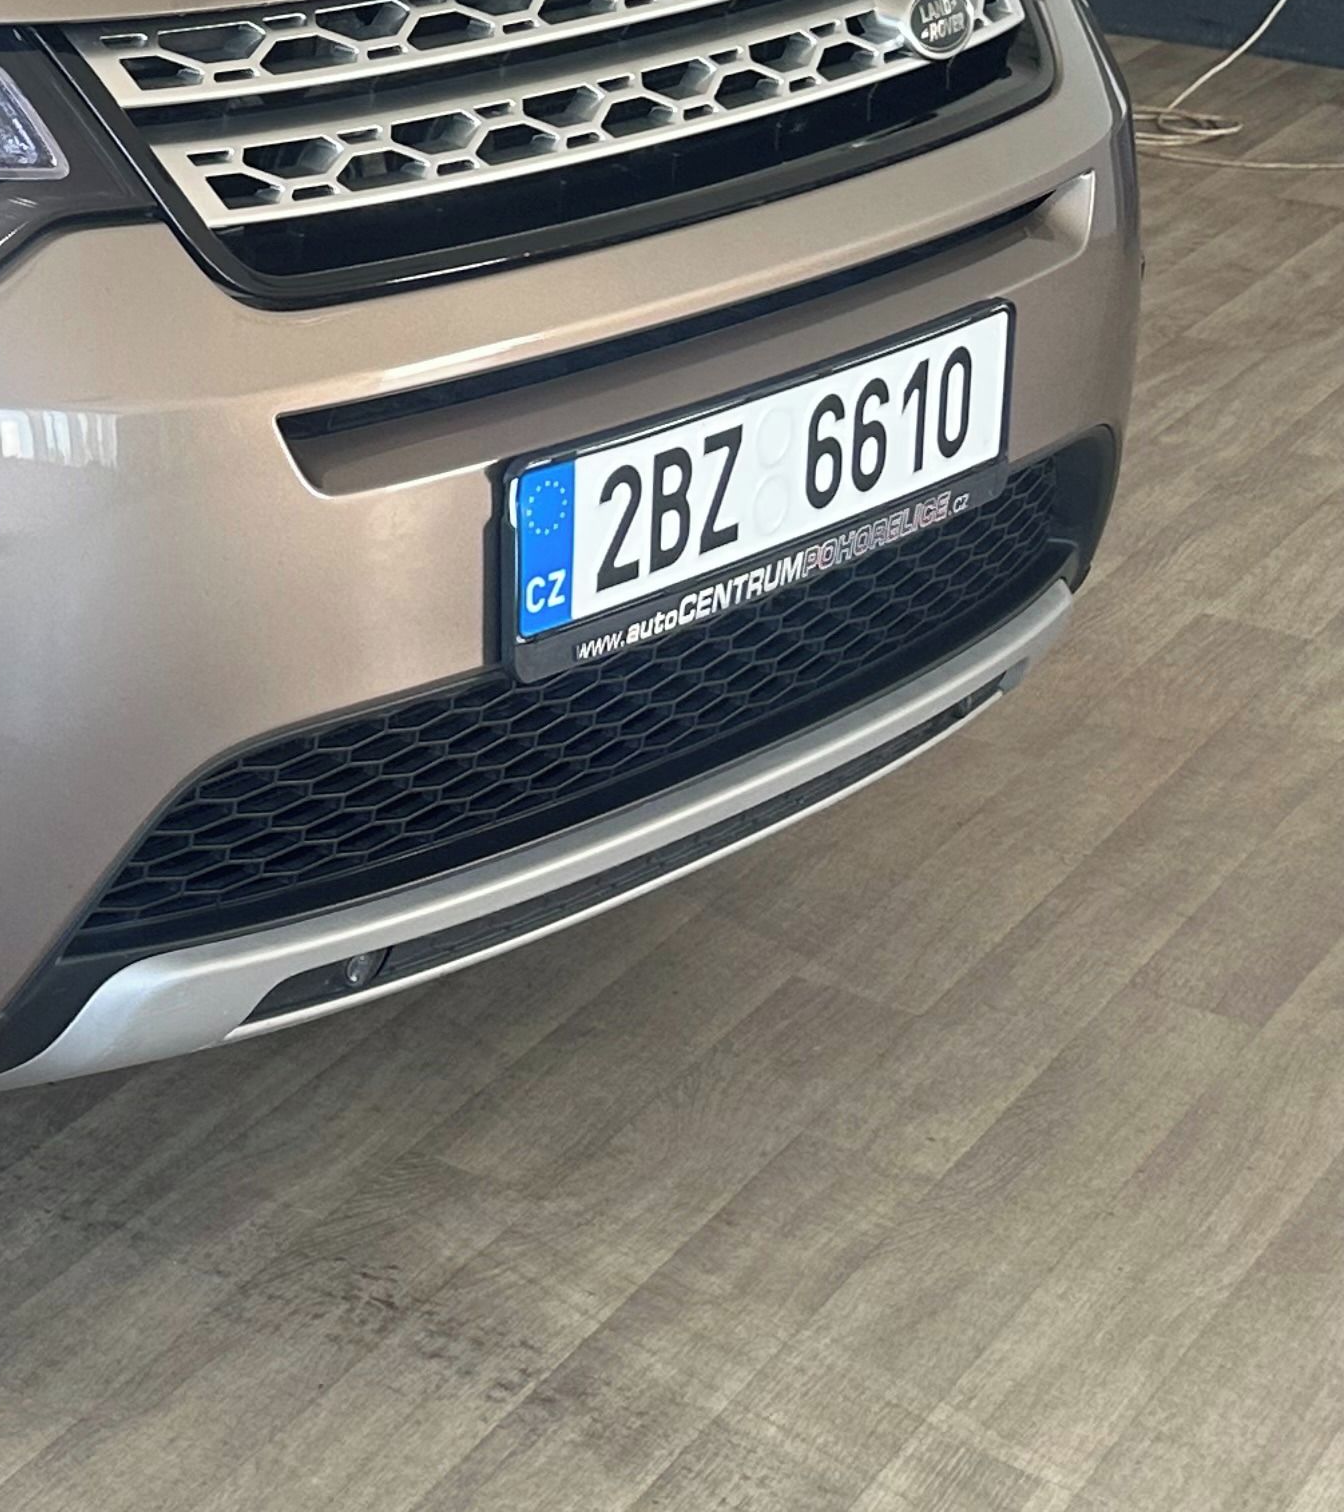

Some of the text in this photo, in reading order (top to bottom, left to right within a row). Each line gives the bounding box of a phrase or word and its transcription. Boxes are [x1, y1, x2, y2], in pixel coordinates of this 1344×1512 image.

[928, 11, 964, 42] ROVER
[596, 345, 973, 593] 2BZ 6610
[525, 568, 566, 614] CZ
